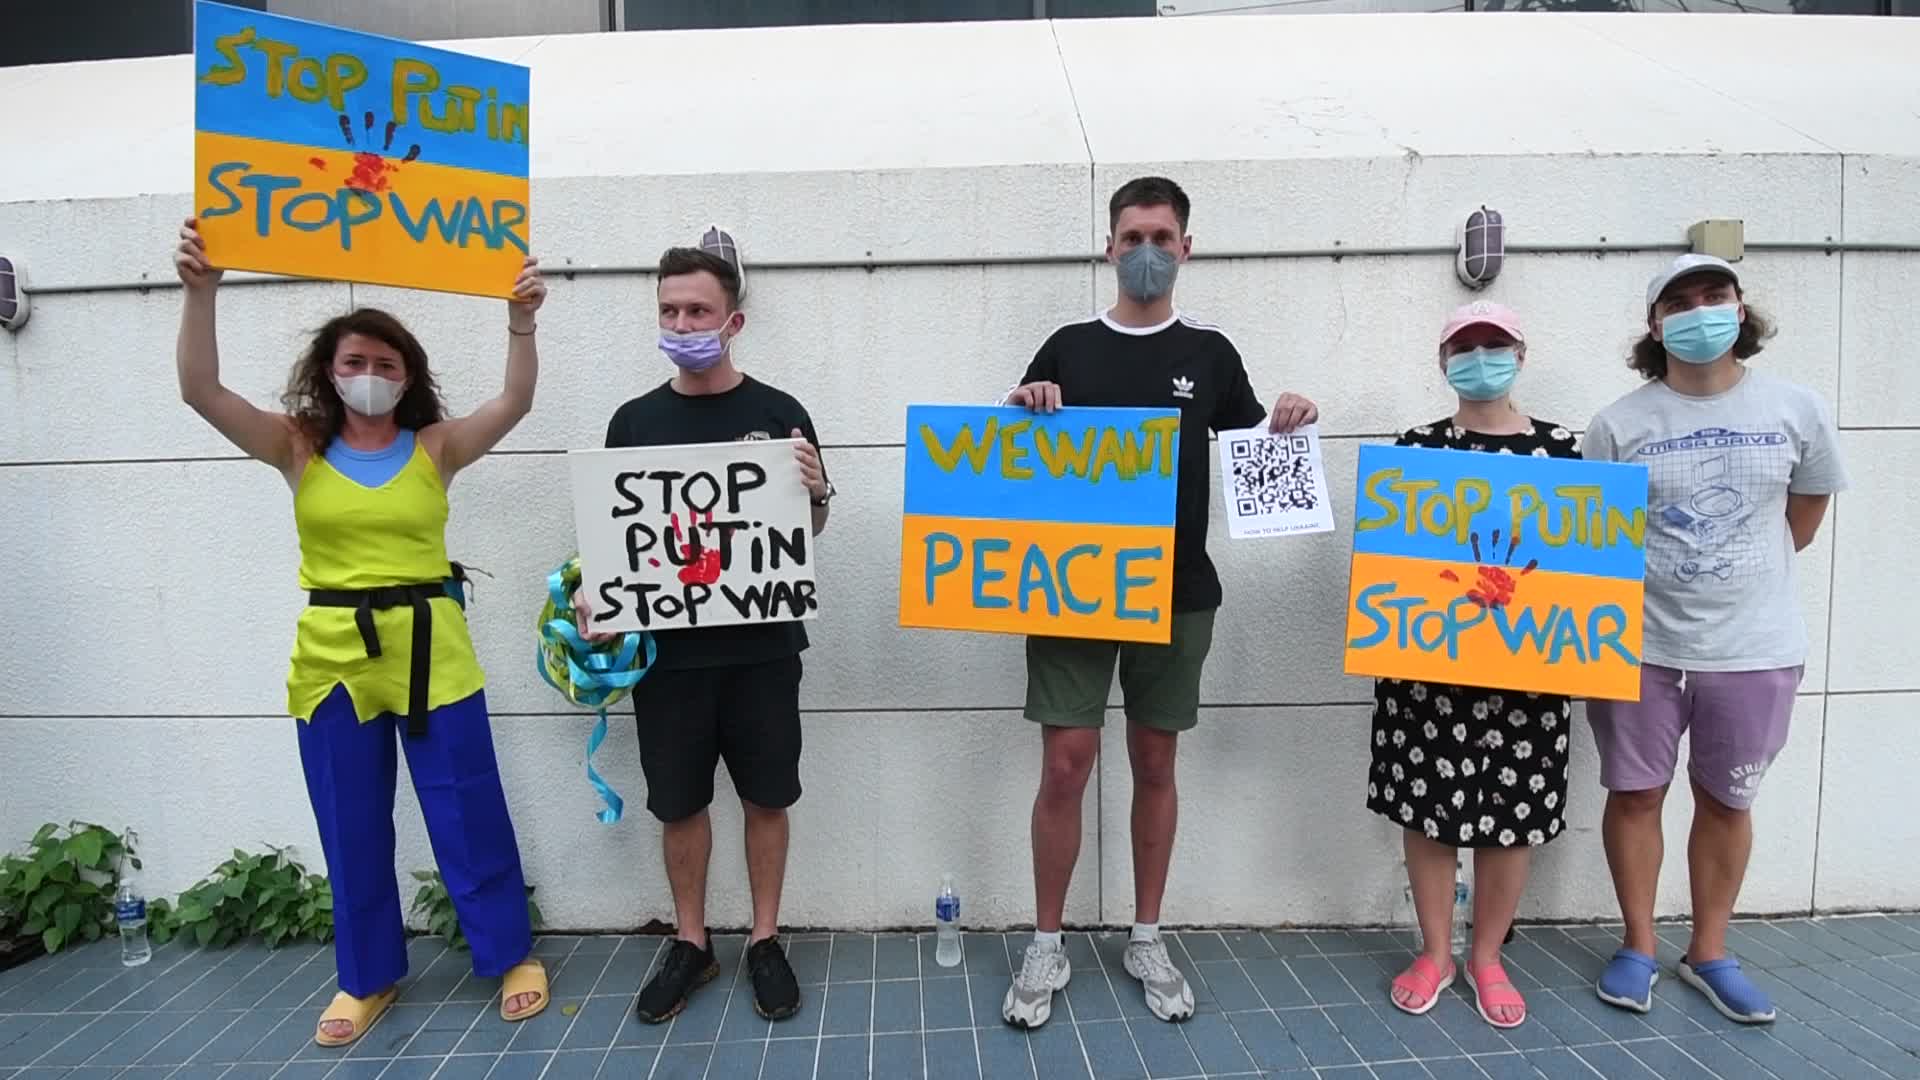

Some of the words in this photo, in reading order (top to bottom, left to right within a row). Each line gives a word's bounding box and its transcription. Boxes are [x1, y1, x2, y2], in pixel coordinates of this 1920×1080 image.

[200, 27, 368, 112] STOP
[202, 162, 382, 251] STOP
[389, 192, 529, 256] WAR
[611, 461, 767, 518] STOP
[1032, 416, 1180, 484] WANT
[1356, 467, 1493, 545] STOP
[719, 580, 818, 620] WAR
[923, 532, 1163, 624] PEACE
[1349, 582, 1489, 660] STOP
[1490, 602, 1640, 667] WAR
